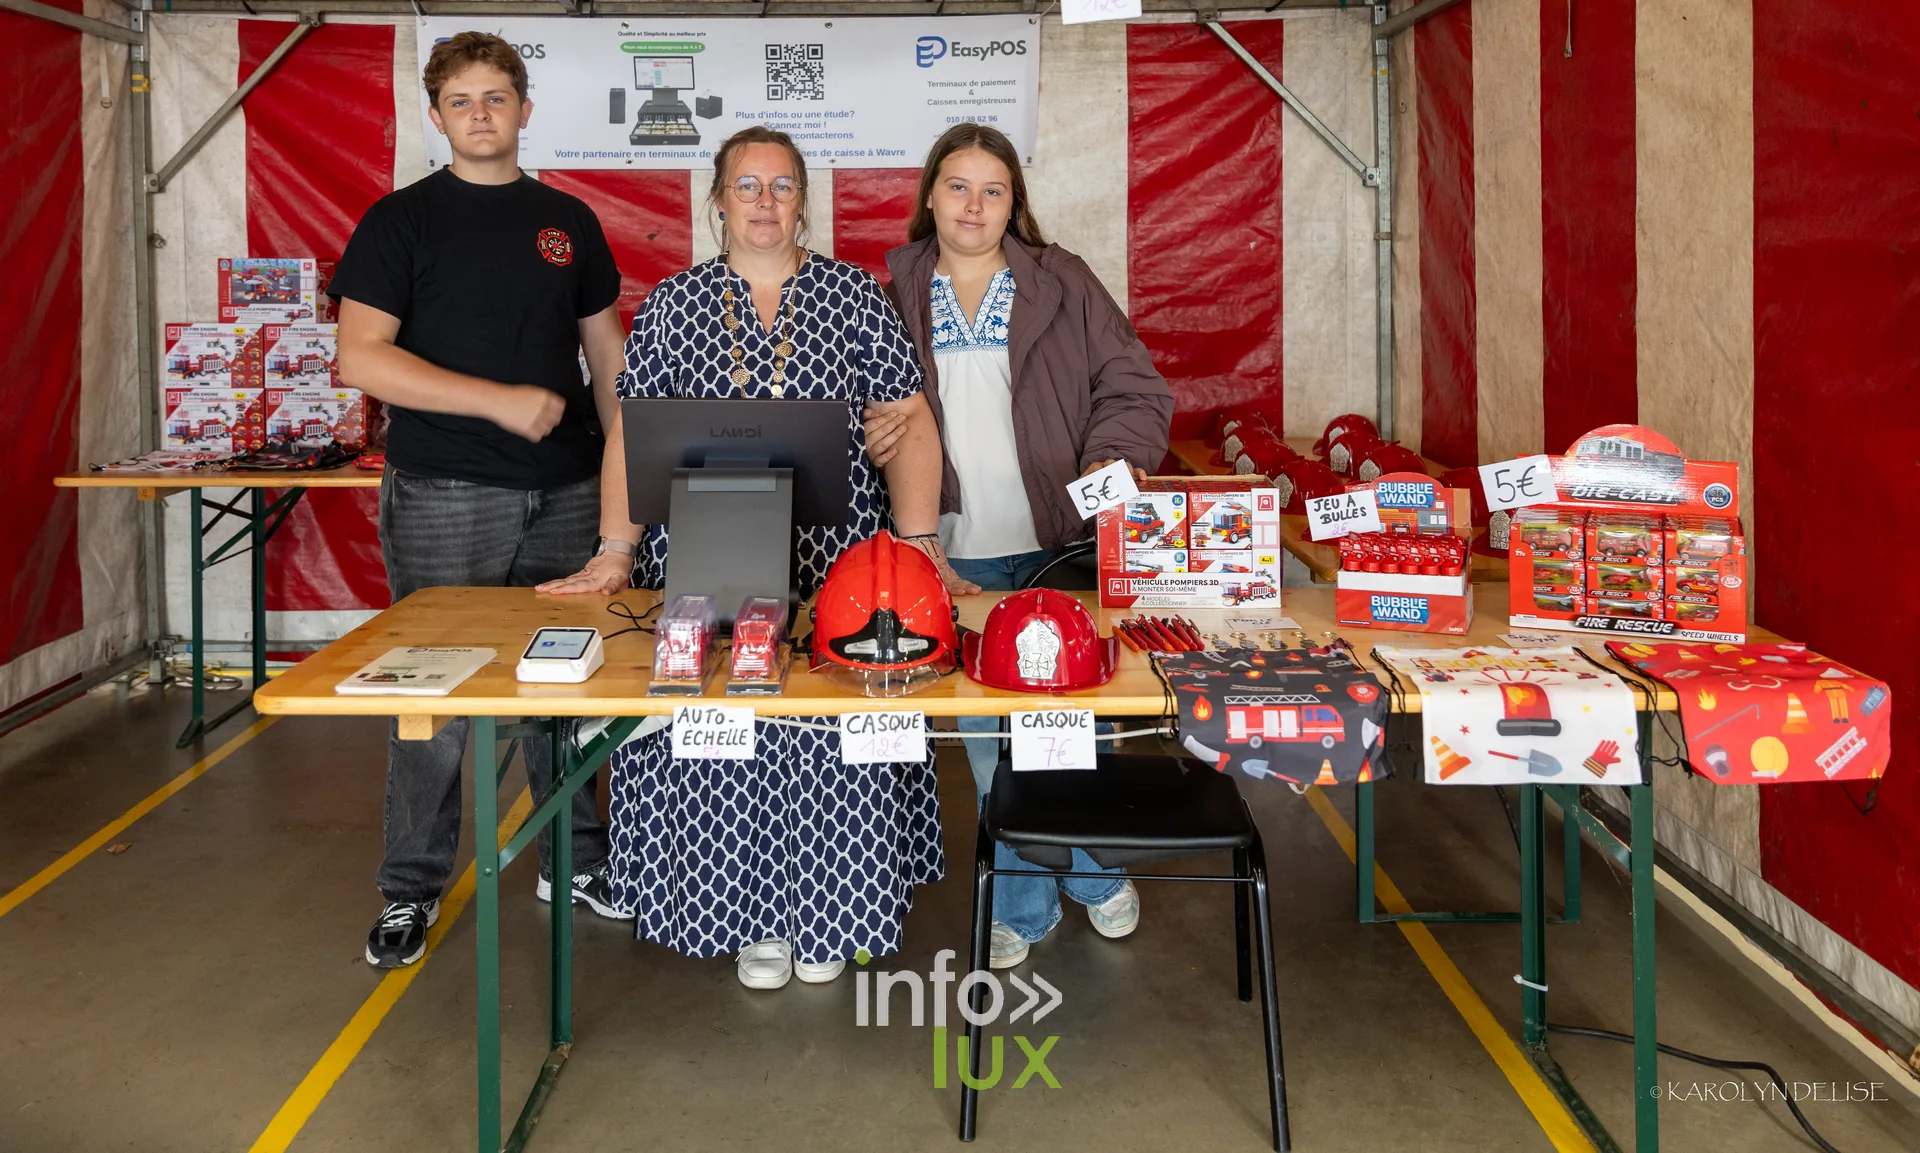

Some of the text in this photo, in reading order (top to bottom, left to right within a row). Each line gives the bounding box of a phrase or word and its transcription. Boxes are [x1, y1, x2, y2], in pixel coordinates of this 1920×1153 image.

[951, 40, 1027, 61] EasyPOS
[927, 80, 967, 88] Terminaux
[980, 79, 1016, 88] paiement
[927, 97, 1017, 106] Caisses enregistreuses
[735, 111, 755, 119] Plus
[757, 111, 788, 119] d'infos
[824, 110, 855, 118] étude?
[763, 121, 802, 129] Scannez
[804, 121, 821, 129] moi
[555, 150, 580, 158] Votre
[582, 150, 632, 160] partenaire
[649, 150, 696, 158] terminaux
[699, 150, 711, 158] de
[820, 149, 832, 157] de
[834, 149, 865, 157] caisse
[868, 148, 874, 156] à
[876, 148, 906, 157] Wavre
[1377, 482, 1434, 494] BUBBLE
[1494, 464, 1544, 503] 5€
[1081, 475, 1120, 511] 5€
[1384, 493, 1427, 505] WAND
[1313, 498, 1340, 512] JEU
[1320, 506, 1367, 525] BULLES
[1332, 522, 1349, 536] 2€
[1132, 578, 1169, 586] VÉHICULE
[1371, 595, 1428, 610] BUBBLE
[1377, 607, 1421, 620] WAND
[1574, 616, 1675, 634] FIRE RESCUE
[1680, 630, 1739, 642] SPEED WHEELS
[846, 713, 921, 735] CASQUE
[1021, 711, 1089, 730] CASQUE
[703, 746, 723, 756] 5€
[860, 735, 908, 758] 12€
[1037, 736, 1076, 768] 7€
